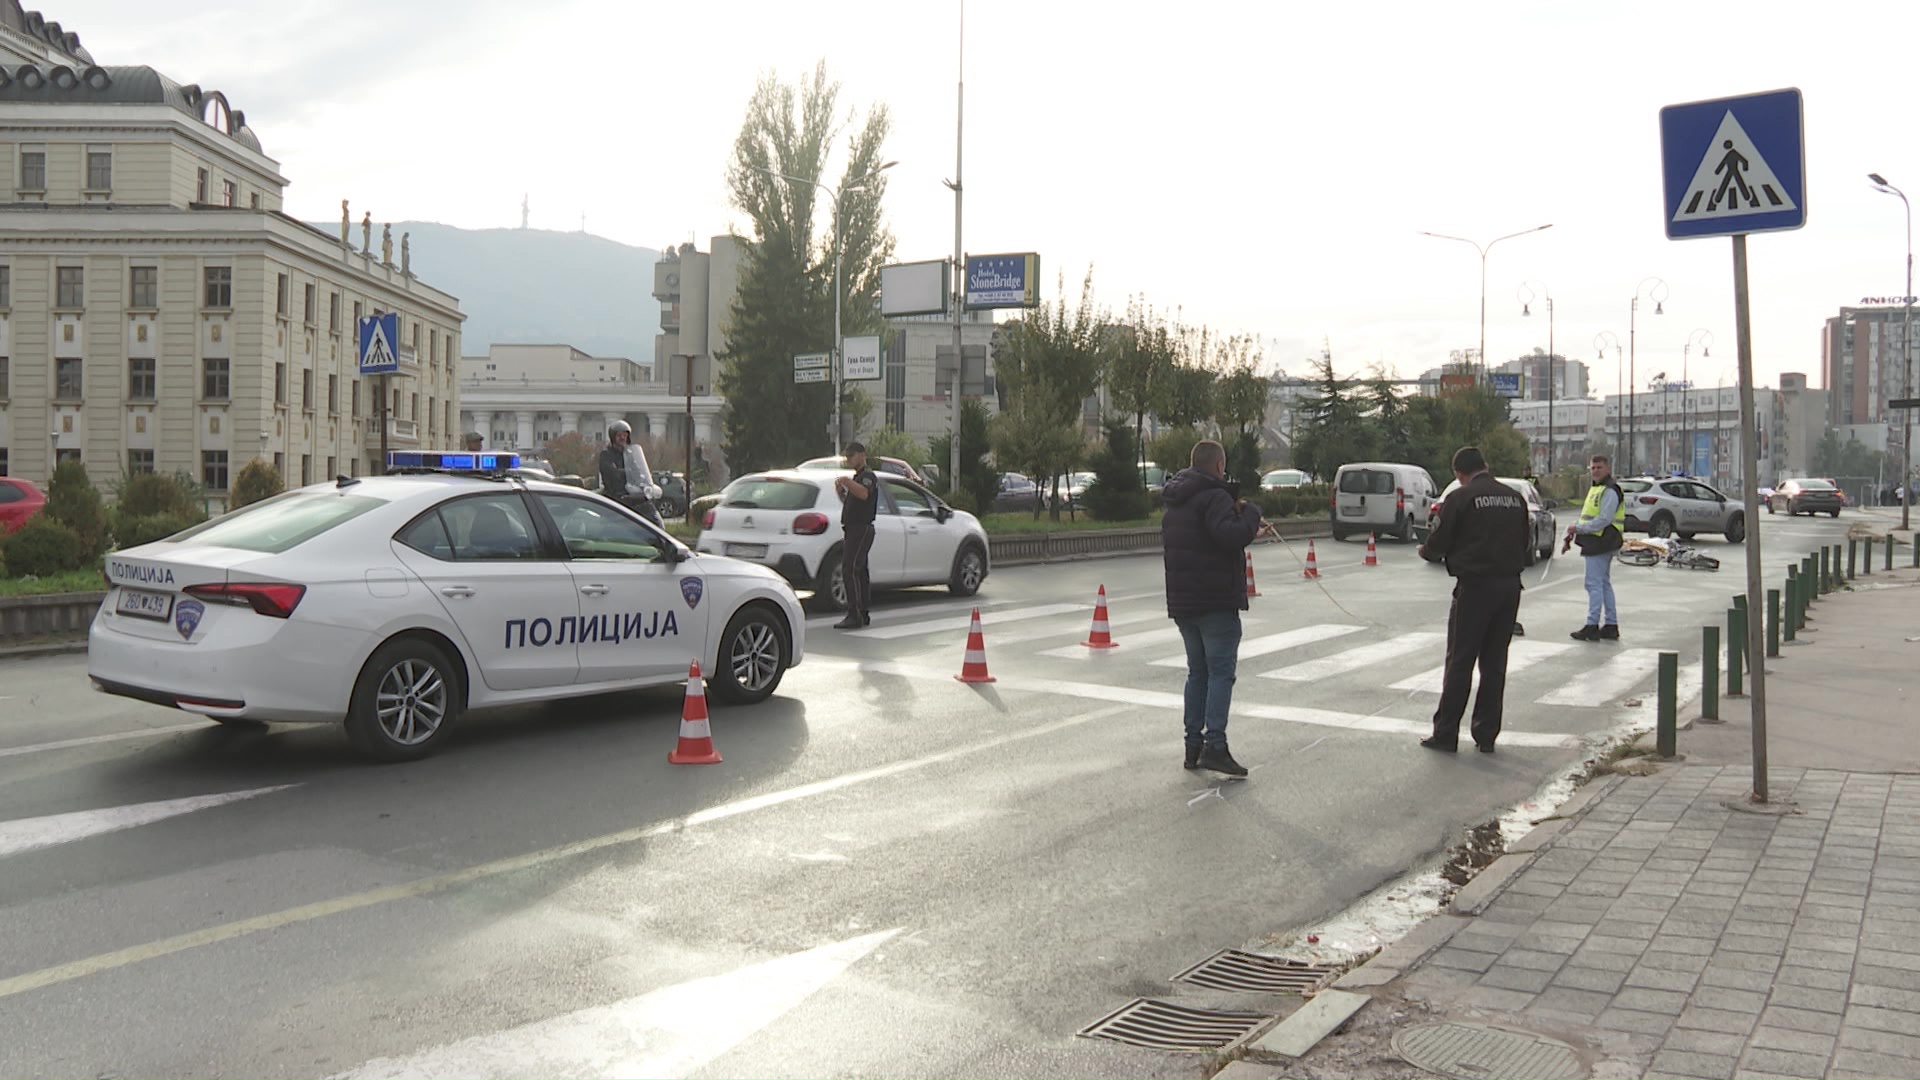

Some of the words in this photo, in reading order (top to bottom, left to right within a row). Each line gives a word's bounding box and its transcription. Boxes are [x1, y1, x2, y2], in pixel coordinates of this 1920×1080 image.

[970, 272, 1021, 289] StoneBridge
[978, 268, 995, 277] Hotel
[112, 562, 175, 584] ПОЛИЦИЈА
[505, 610, 679, 649] ПОЛИЦИЈА
